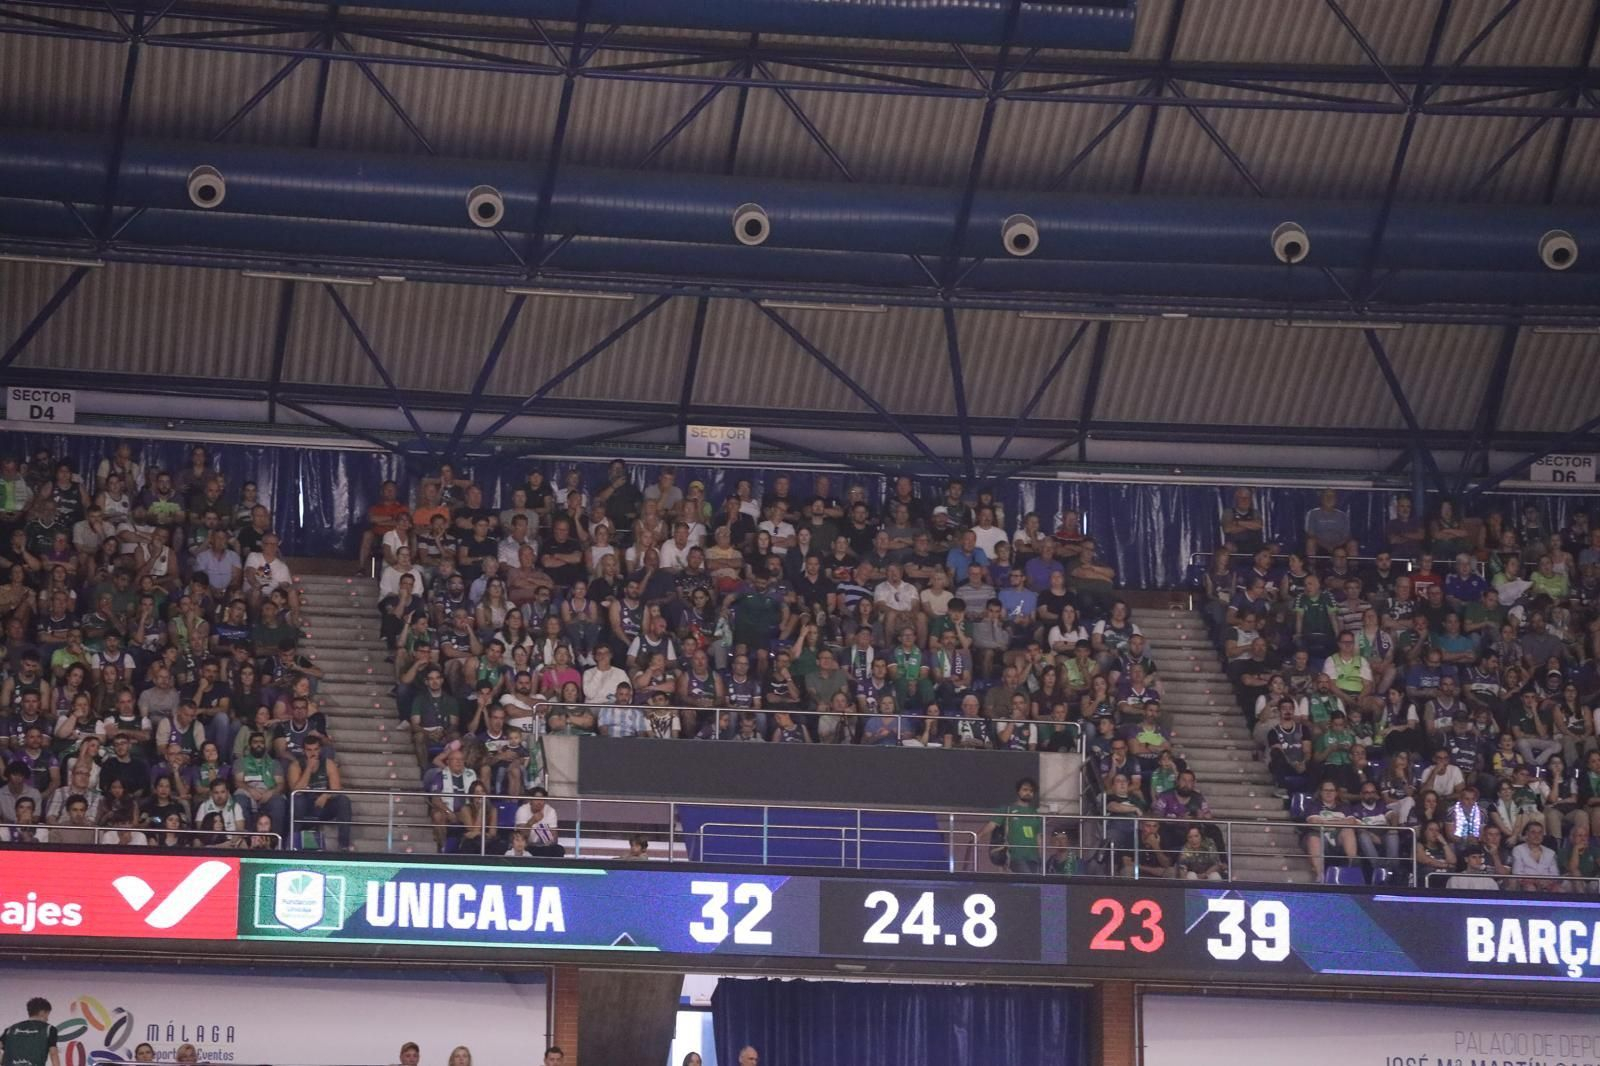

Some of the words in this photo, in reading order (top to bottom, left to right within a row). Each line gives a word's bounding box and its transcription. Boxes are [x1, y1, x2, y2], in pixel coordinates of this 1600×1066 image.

[12, 389, 71, 403] SECTOR
[29, 405, 55, 420] D4
[690, 427, 746, 440] SECTOR
[706, 441, 731, 458] D5
[1535, 456, 1592, 468] SECTOR
[1552, 470, 1577, 483] D6
[0, 891, 83, 932] ajes
[365, 880, 566, 933] UNICAJA
[689, 881, 774, 945] 32
[862, 890, 998, 948] 24.8
[1089, 898, 1165, 953] 23
[1206, 898, 1291, 962] 39
[146, 1020, 236, 1043] MÁLAGA
[197, 1047, 235, 1061] Eventos
[1455, 1030, 1528, 1056] PALACIO
[1532, 1033, 1554, 1057] DE
